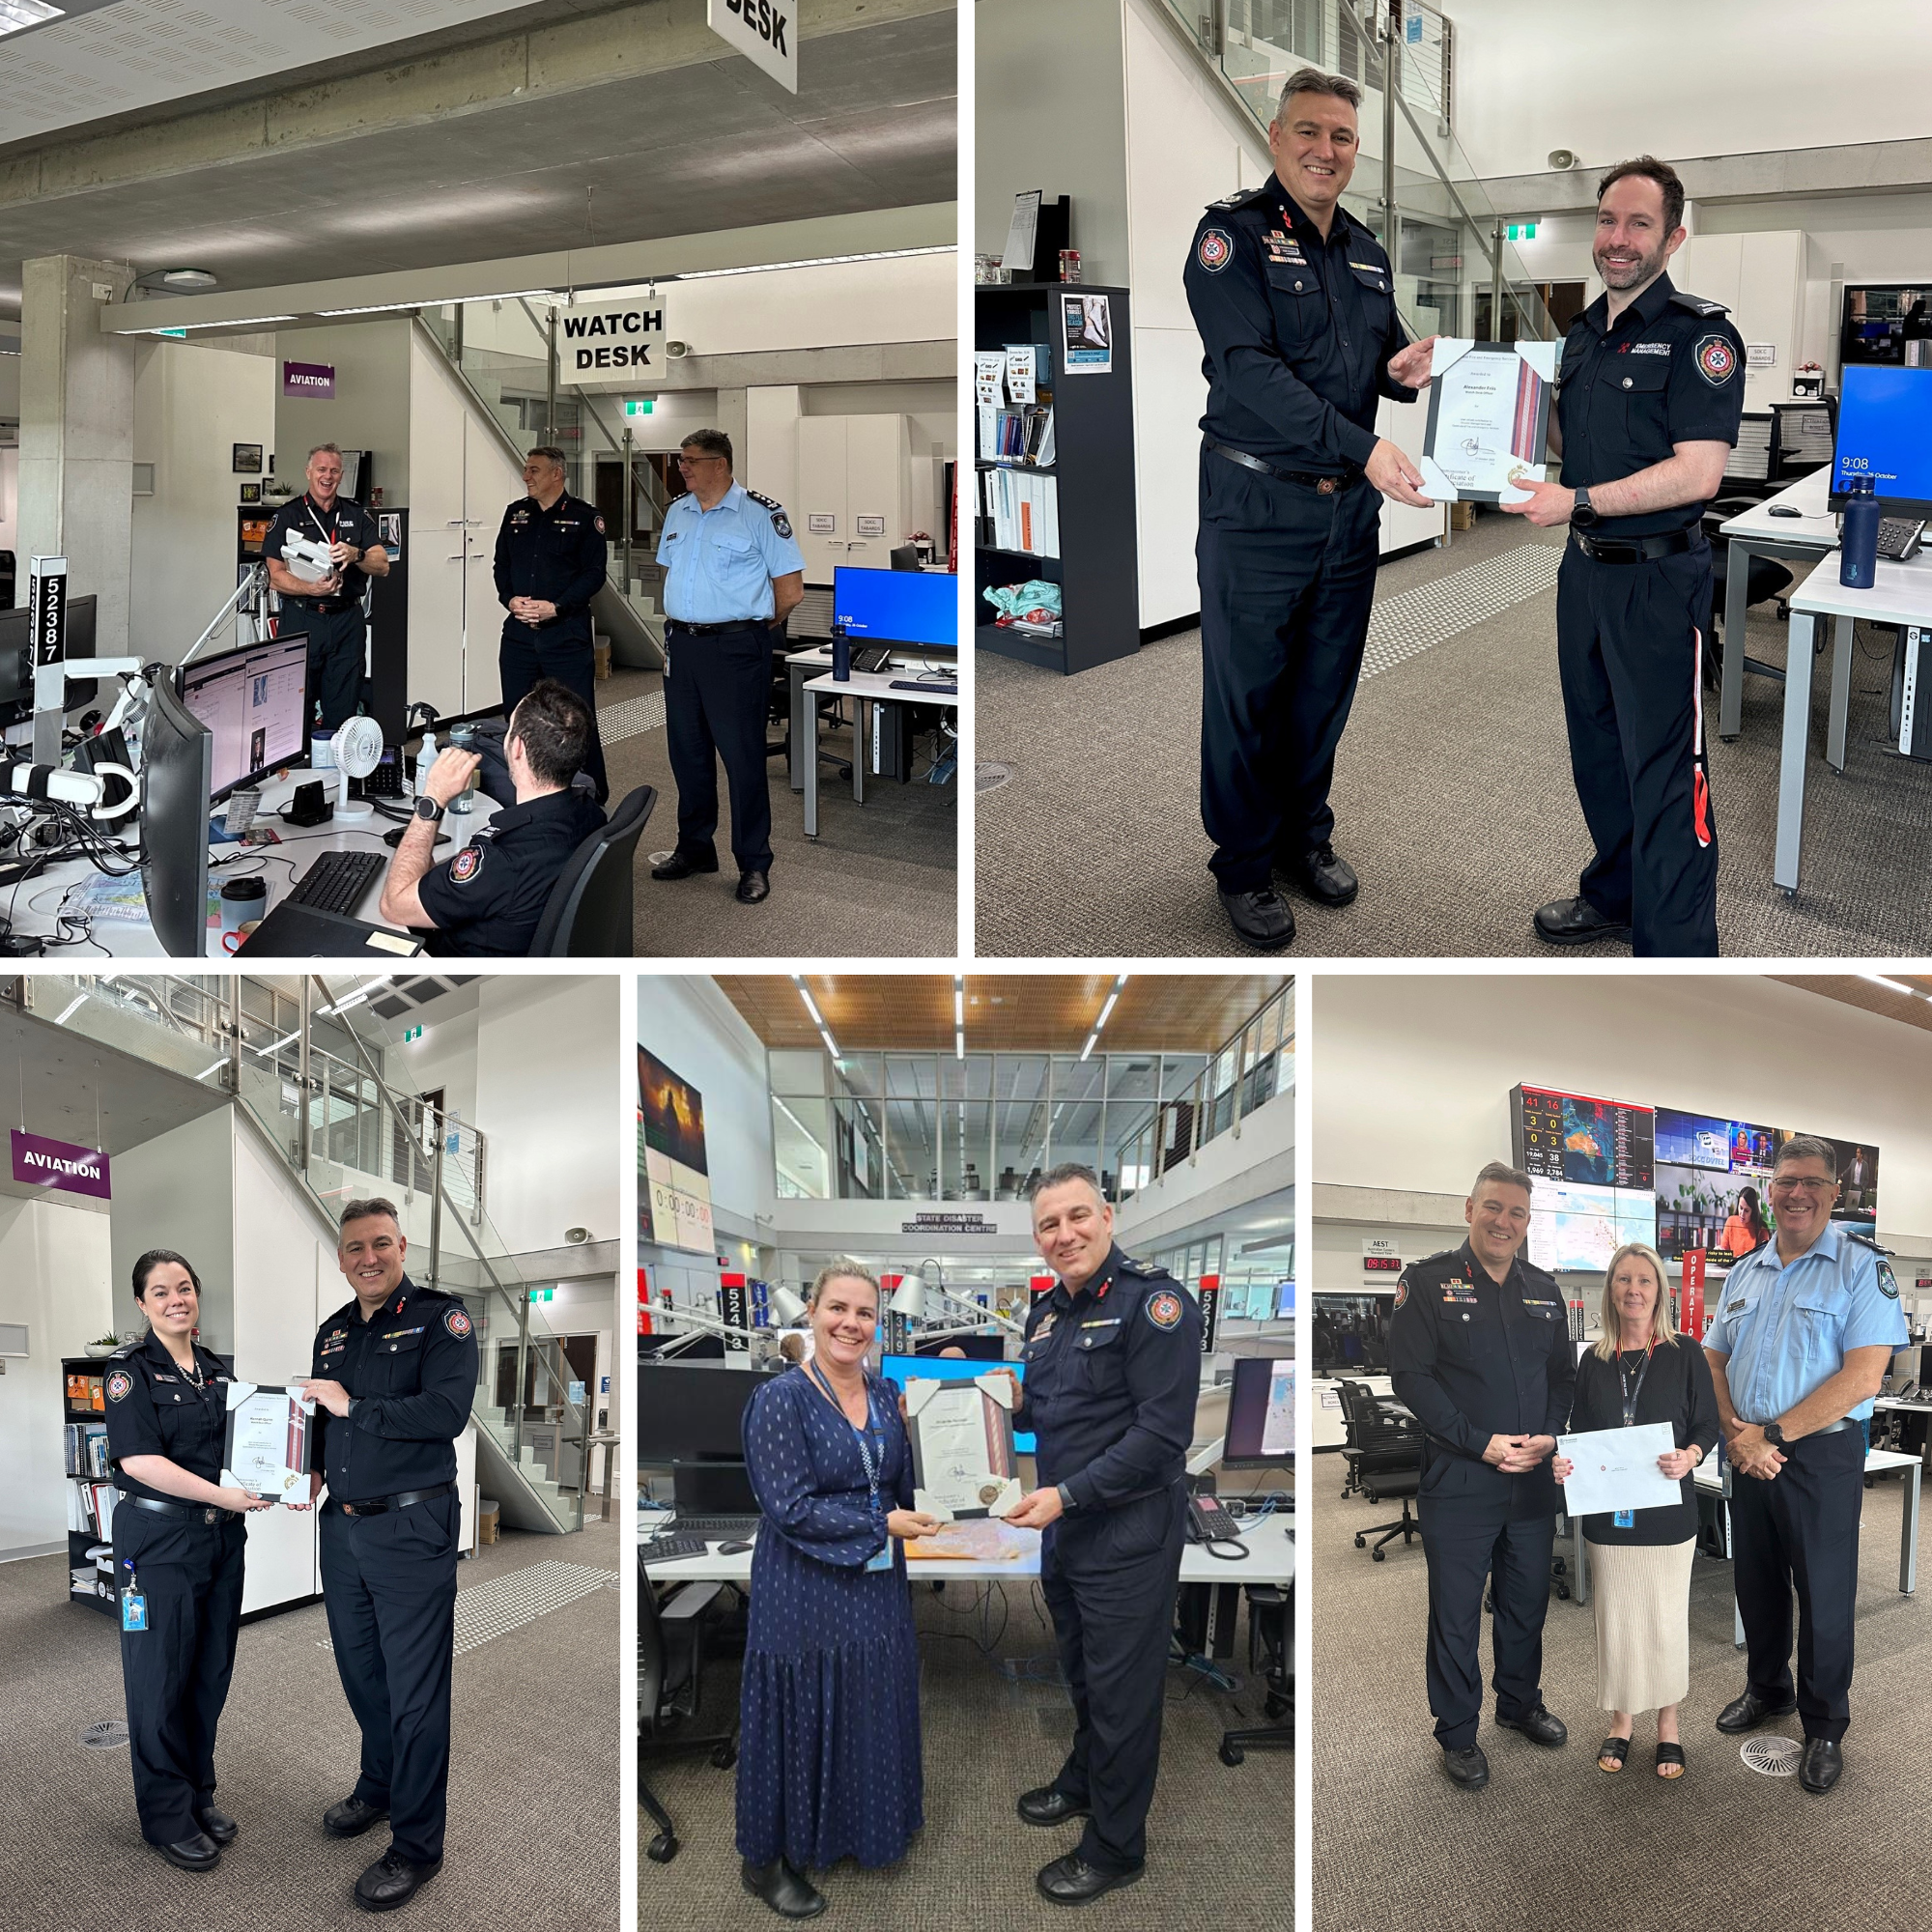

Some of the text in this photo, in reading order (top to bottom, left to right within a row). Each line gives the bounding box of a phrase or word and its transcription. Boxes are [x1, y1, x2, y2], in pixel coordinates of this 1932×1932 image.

[564, 310, 662, 338] WATCH
[576, 344, 651, 369] DESK
[290, 374, 330, 387] AVIATION
[1842, 456, 1869, 469] 9:08
[45, 578, 59, 661] 52387
[1526, 1097, 1538, 1107] 41
[1547, 1100, 1559, 1109] 16
[1530, 1116, 1536, 1125] 3
[1550, 1119, 1557, 1128] 0
[1531, 1133, 1537, 1143] 0
[1551, 1136, 1557, 1145] 3
[1549, 1153, 1559, 1162] 38
[24, 1151, 100, 1180] AVIATION
[902, 1224, 963, 1232] COORDINATION
[1688, 1255, 1697, 1336] OPERATIO
